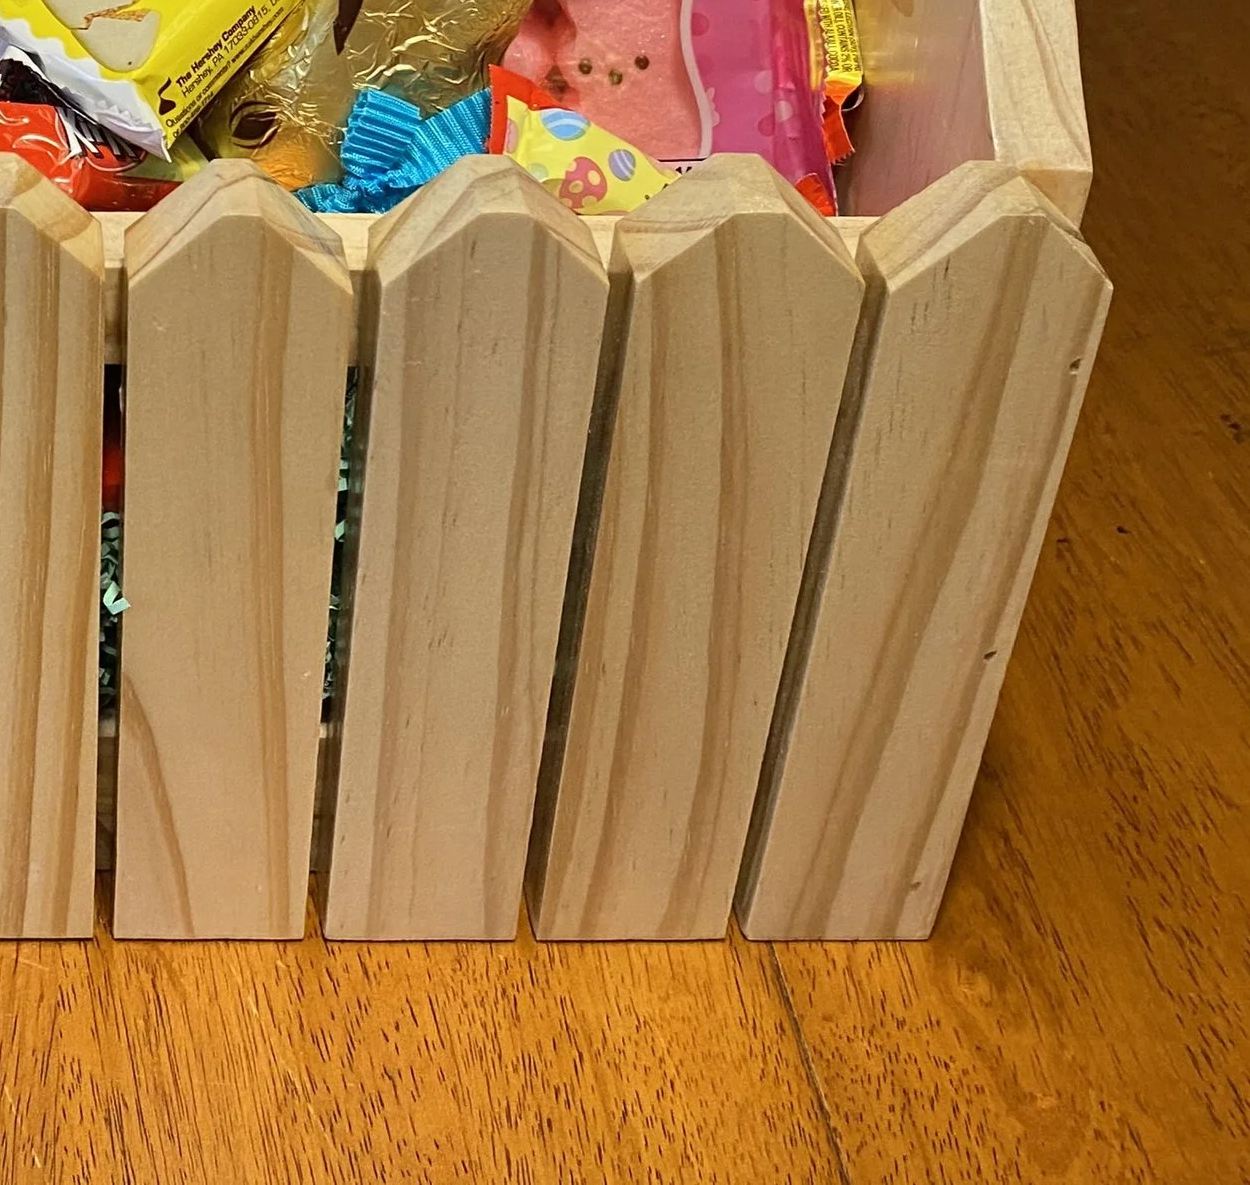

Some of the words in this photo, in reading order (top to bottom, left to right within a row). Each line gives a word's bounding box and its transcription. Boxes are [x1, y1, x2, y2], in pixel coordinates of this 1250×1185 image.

[175, 68, 194, 89] The
[191, 38, 225, 74] Hershey
[221, 4, 258, 43] Company
[180, 63, 214, 99] Hershey,
[211, 51, 225, 67] PA
